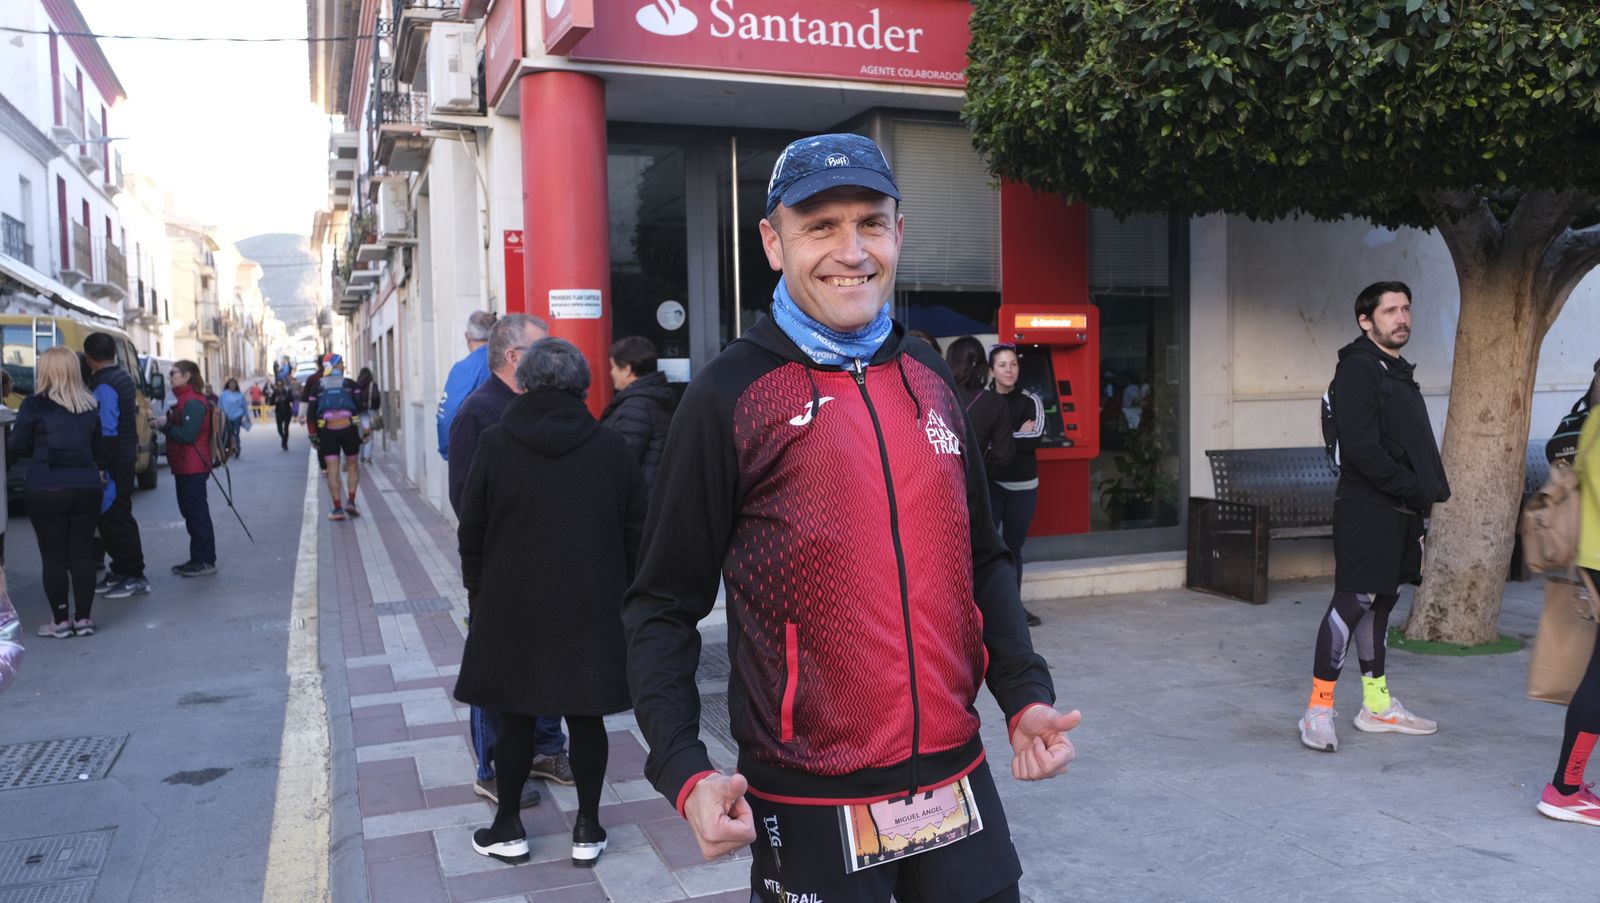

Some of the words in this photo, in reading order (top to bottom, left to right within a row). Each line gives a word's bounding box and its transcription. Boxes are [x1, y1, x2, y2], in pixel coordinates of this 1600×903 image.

[710, 0, 923, 53] Santander
[860, 64, 896, 77] AGENTE
[897, 67, 964, 82] COLABORADOR
[828, 156, 847, 167] Buff
[930, 440, 961, 455] TRAIL
[894, 813, 921, 825] MIGUEL
[764, 815, 782, 847] TYG
